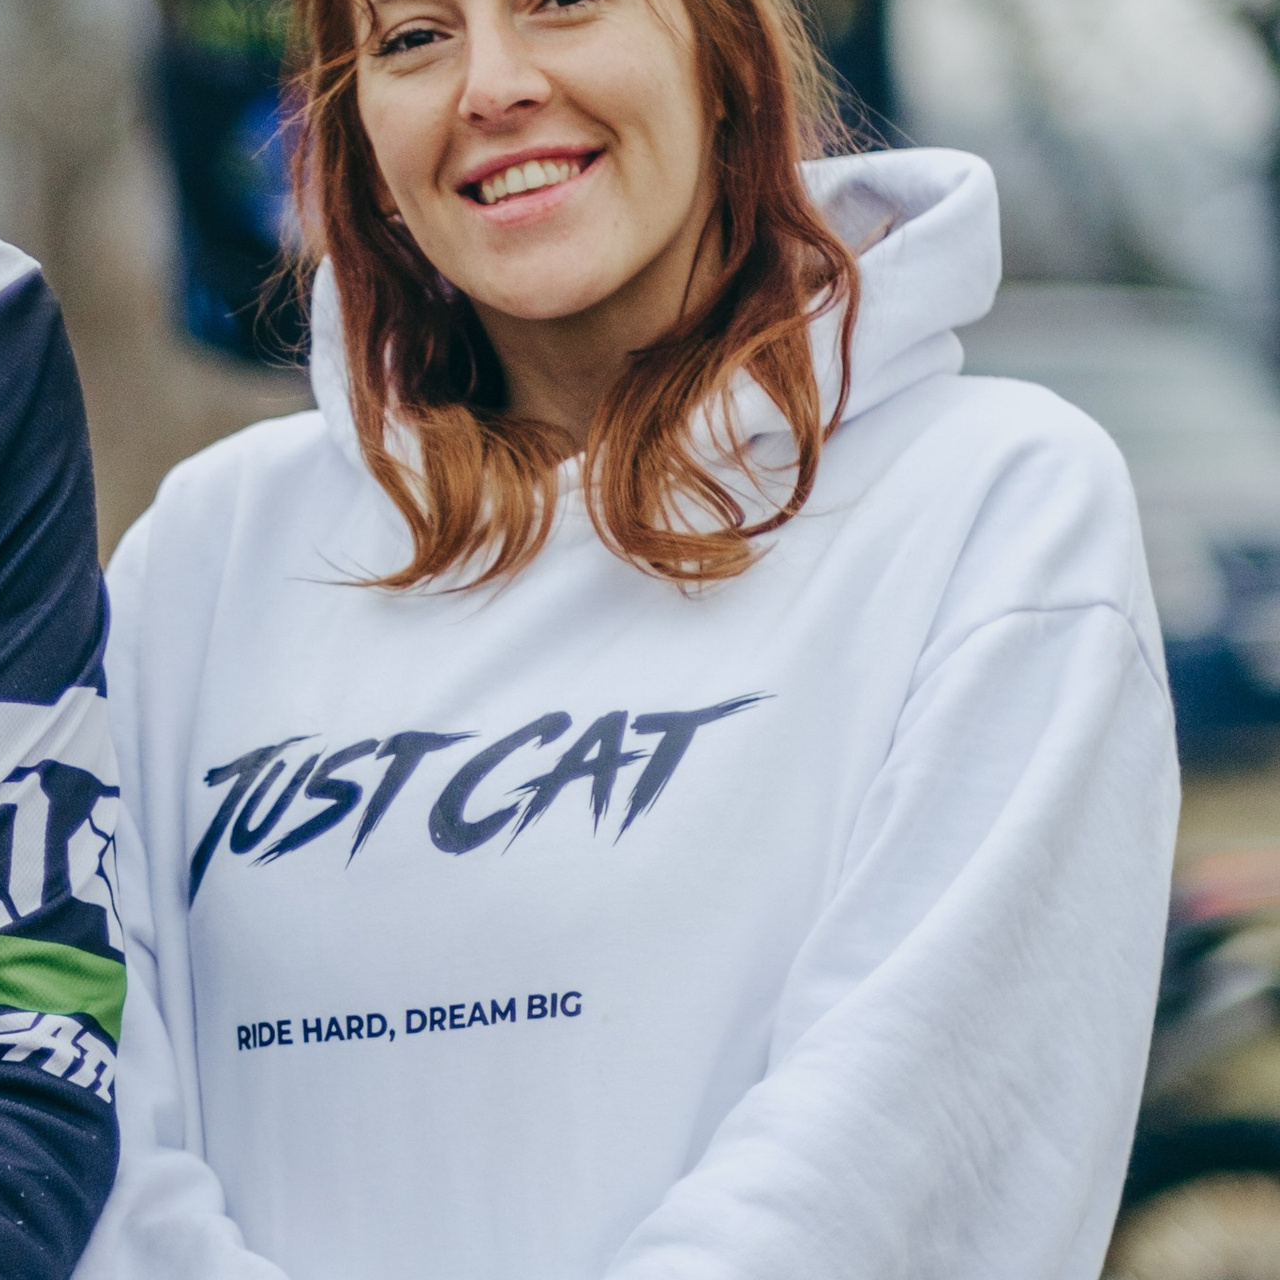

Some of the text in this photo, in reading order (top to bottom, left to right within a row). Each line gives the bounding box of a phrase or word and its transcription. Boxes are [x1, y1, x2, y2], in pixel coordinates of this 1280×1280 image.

[187, 689, 780, 913] JUST CAT
[236, 990, 584, 1052] RIDE HARD, DREAM BIG
